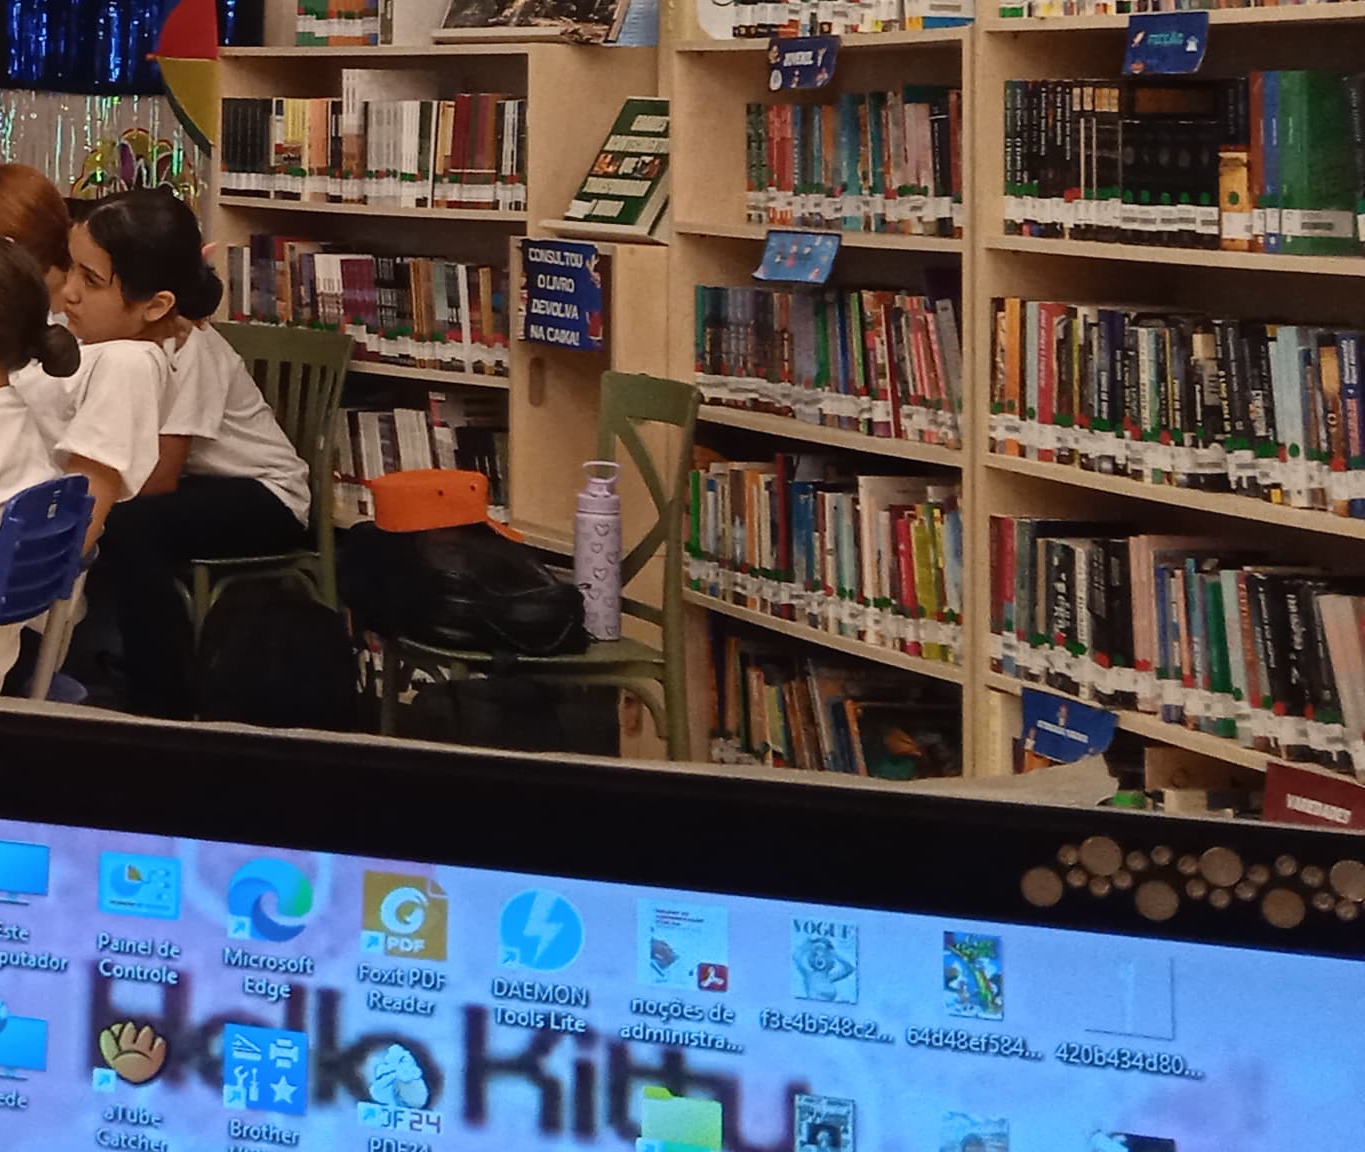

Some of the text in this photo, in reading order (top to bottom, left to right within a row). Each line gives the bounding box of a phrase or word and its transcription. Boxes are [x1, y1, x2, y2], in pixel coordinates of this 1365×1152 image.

[528, 247, 583, 267] CONSULTOU
[547, 274, 575, 293] LIVRO
[530, 297, 580, 321] DEVOLVA
[530, 324, 545, 340] NA
[97, 932, 181, 960] Painel de
[386, 935, 425, 953] PDF
[98, 957, 179, 986] Controle
[223, 947, 315, 975] Microsoft
[242, 976, 293, 1001] Edge
[357, 964, 447, 992] Foxit PDF
[368, 991, 435, 1017] Reader
[492, 978, 589, 1008] DAEMON
[493, 1006, 587, 1035] Tools Lite
[630, 997, 735, 1024] noções de
[103, 1104, 164, 1127] aTube
[228, 1119, 301, 1146] Brother
